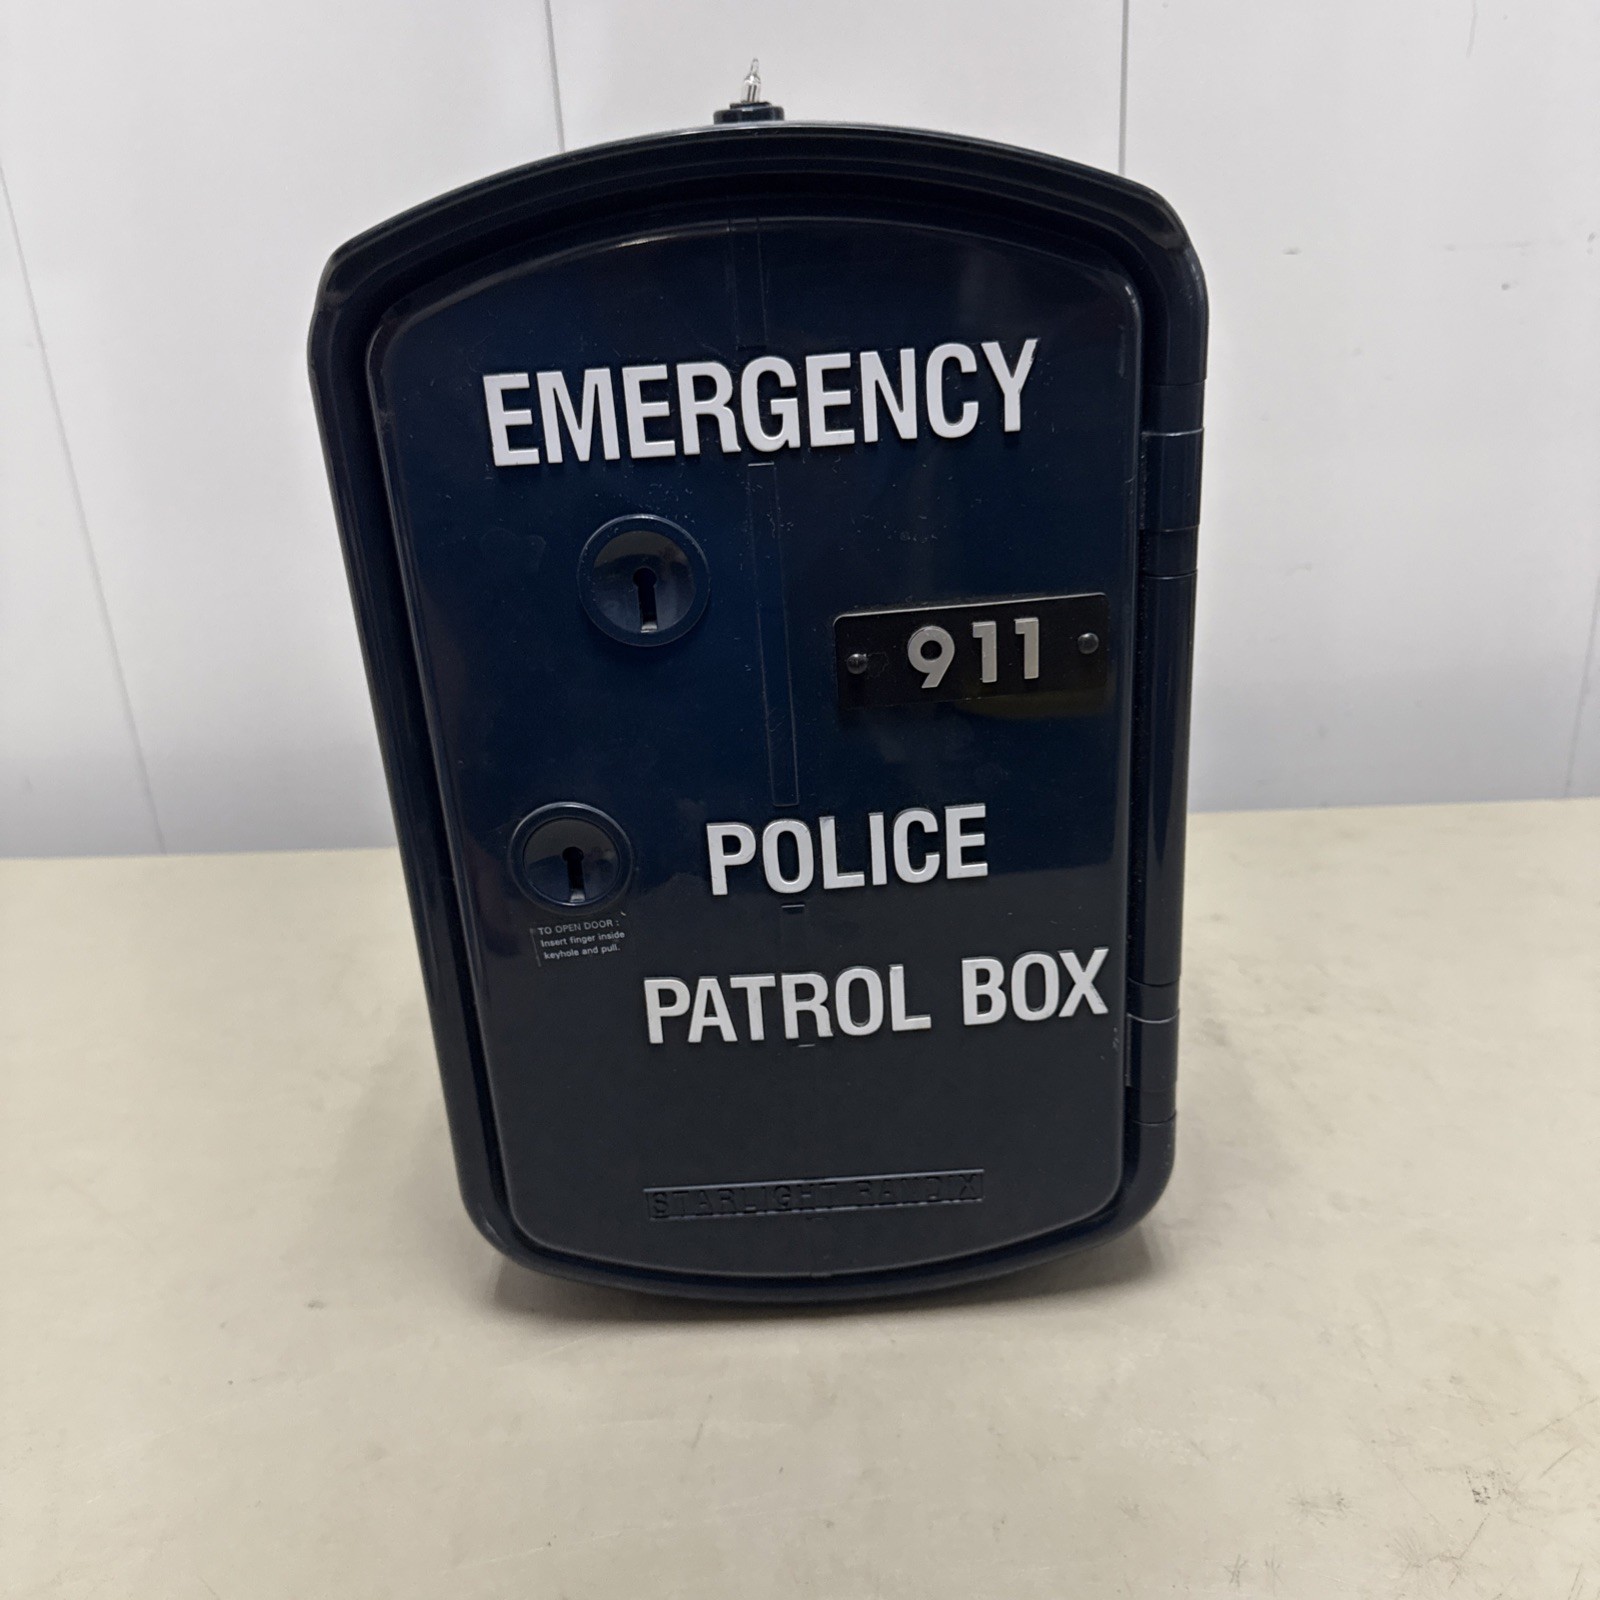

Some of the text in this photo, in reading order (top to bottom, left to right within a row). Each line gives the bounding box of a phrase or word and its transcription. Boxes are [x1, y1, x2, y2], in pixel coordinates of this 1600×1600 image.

[483, 339, 1038, 467] EMERGENCY
[909, 617, 1040, 689] 911
[707, 803, 988, 896] POLICE
[537, 926, 553, 936] TO
[555, 923, 581, 934] OPEN
[541, 930, 626, 948] Insert finger inside
[543, 943, 621, 960] keyhole and pull.
[644, 948, 1109, 1045] PATROL BOX
[651, 1182, 839, 1218] STARLIGHT
